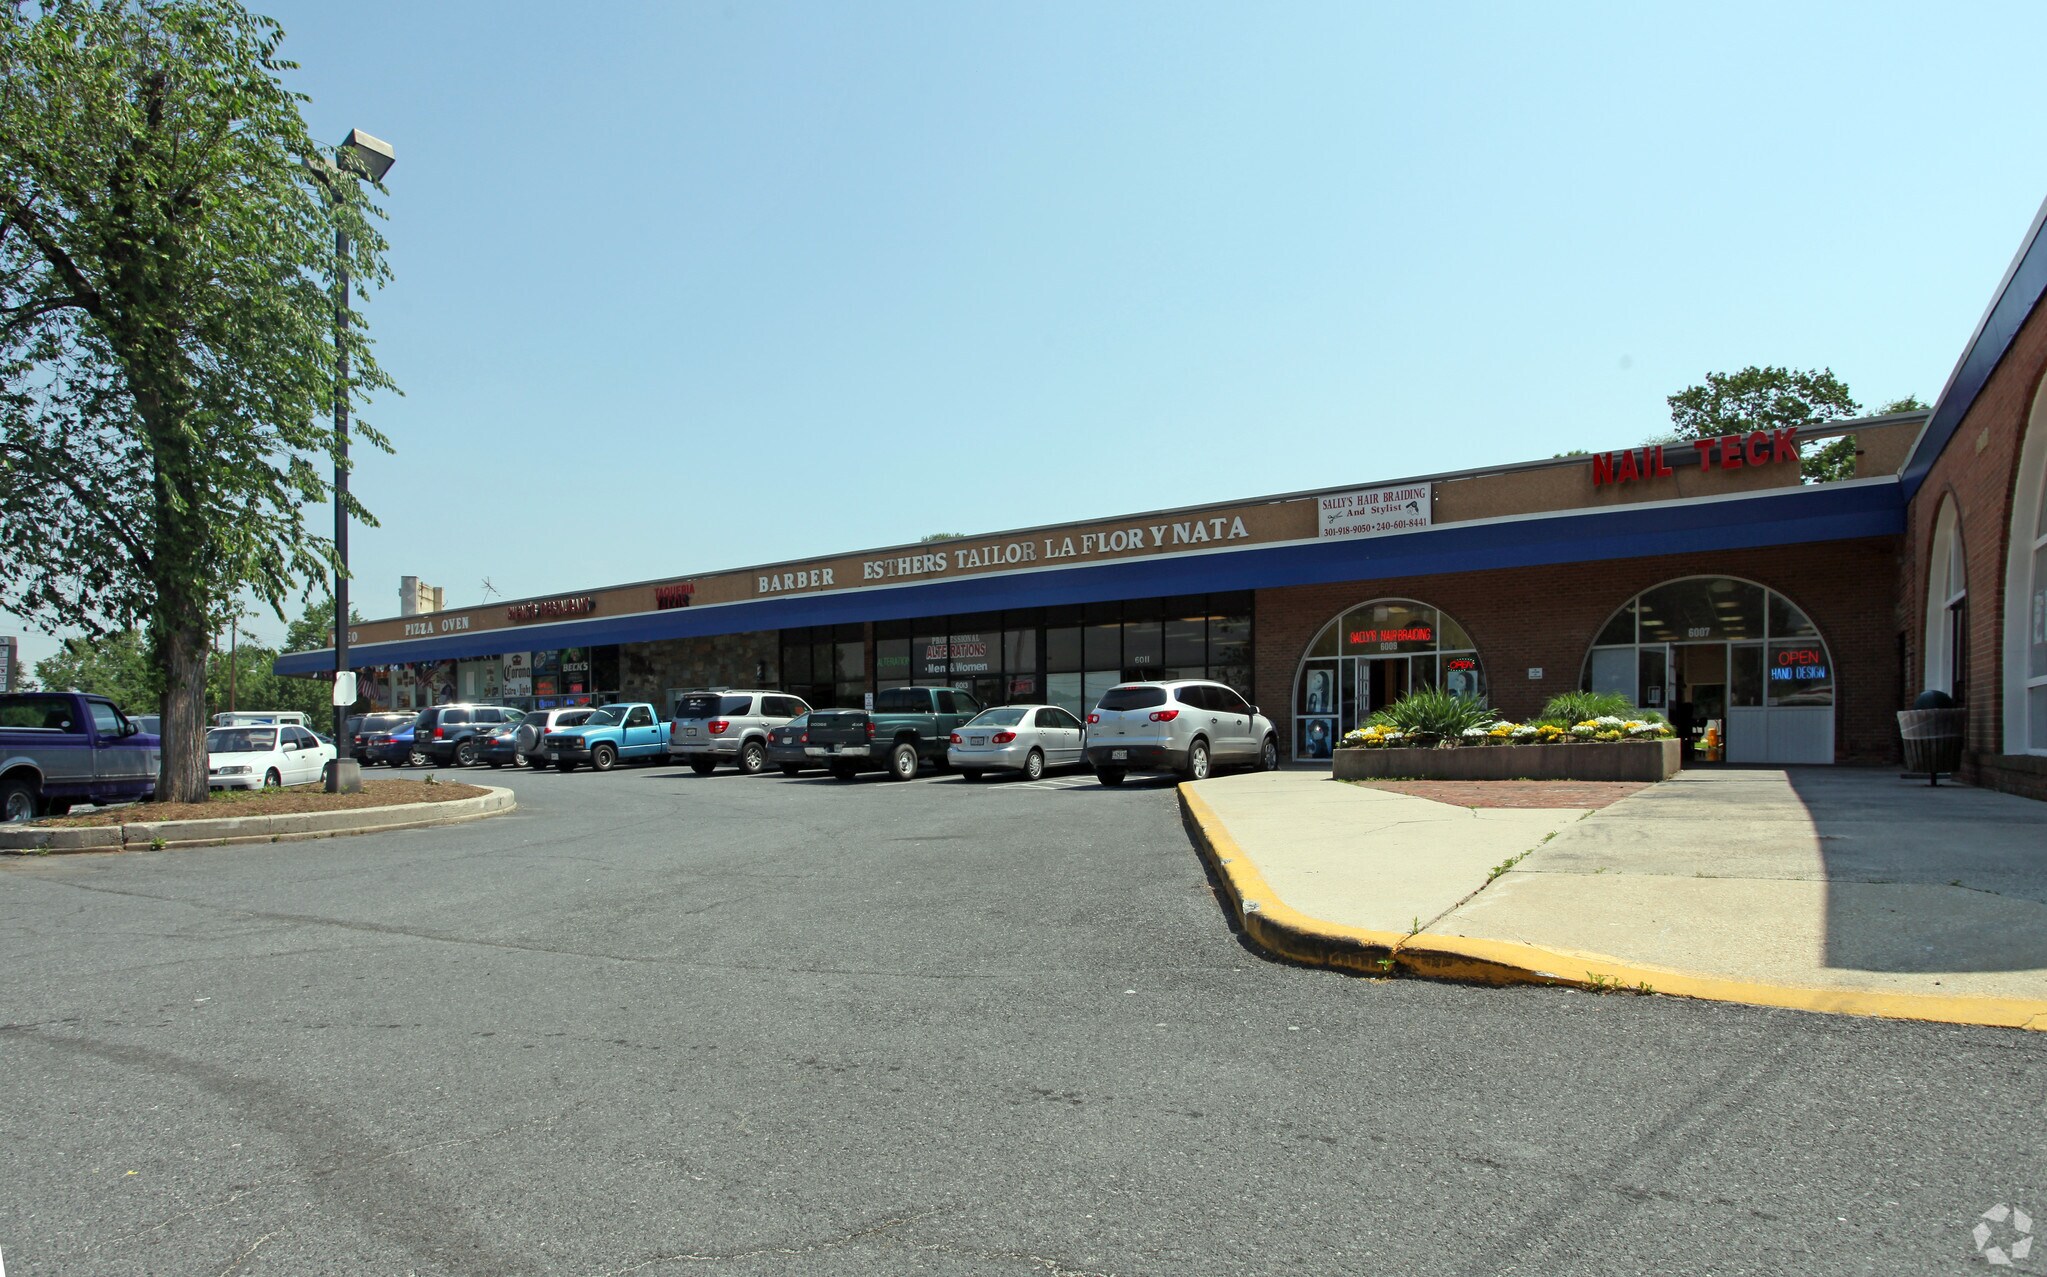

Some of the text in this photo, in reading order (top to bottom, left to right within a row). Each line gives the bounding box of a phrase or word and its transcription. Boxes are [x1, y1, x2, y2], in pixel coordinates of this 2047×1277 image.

[1593, 427, 1800, 487] NAIL TECK
[1322, 487, 1426, 510] SALLY'S HAIR BRAIDING
[1346, 503, 1402, 517] And Stylist
[1324, 517, 1427, 537] 301-918-9050 240-601-8441
[1044, 516, 1249, 559] LA FLOR Y NATA
[863, 541, 1037, 580] ESTHERS TAILOR
[758, 568, 834, 593] BARBER
[405, 617, 469, 636] PIZZA OVEN
[1688, 627, 1711, 638] 6007
[931, 634, 979, 645] PROFESSIONAL
[1380, 641, 1398, 651] 6009
[926, 643, 986, 659] ALTERATIONS
[1778, 650, 1819, 666] OPEN
[562, 661, 589, 672] BECK'S
[955, 662, 988, 672] Women
[1450, 660, 1474, 670] OPEN
[1771, 666, 1825, 680] HAND DESIGN
[503, 665, 530, 683] Corona
